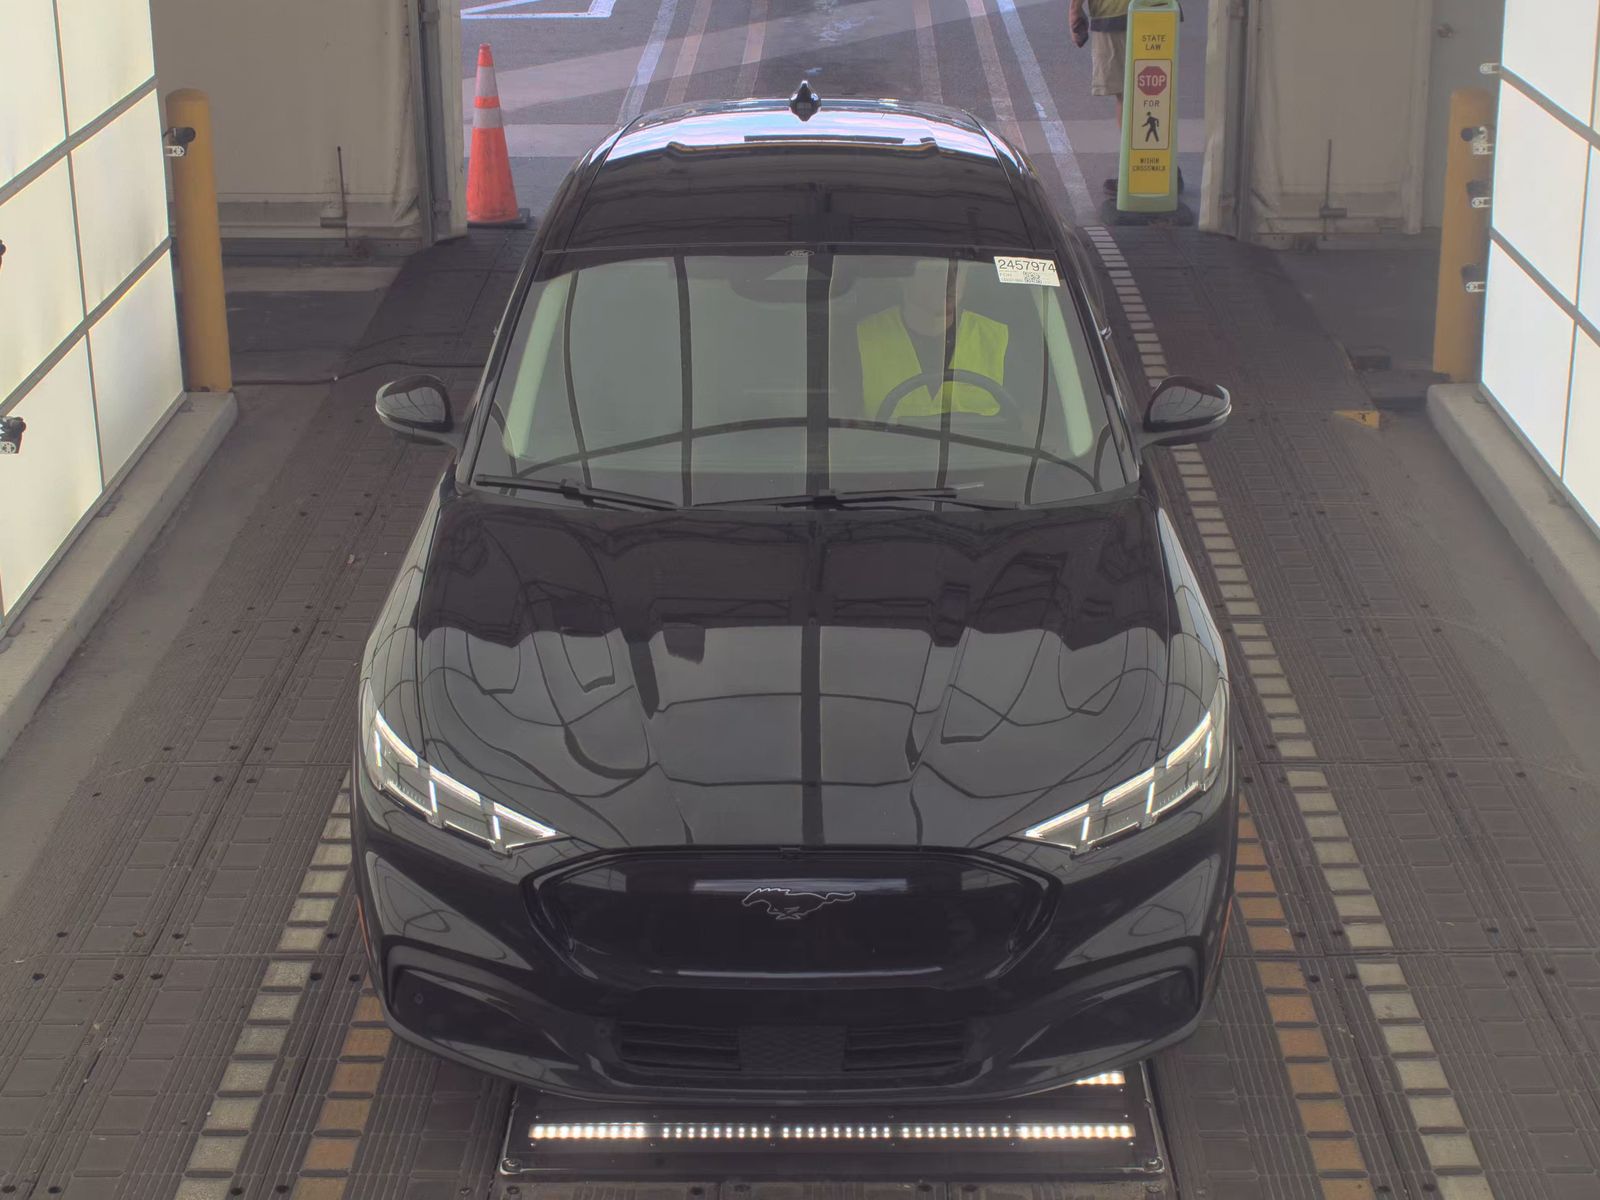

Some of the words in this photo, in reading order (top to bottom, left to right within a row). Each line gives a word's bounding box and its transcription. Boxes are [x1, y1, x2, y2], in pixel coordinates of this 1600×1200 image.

[1142, 34, 1166, 42] STATE
[1139, 75, 1166, 87] STOP
[1143, 100, 1160, 108] FOR
[998, 259, 1056, 273] 2457974
